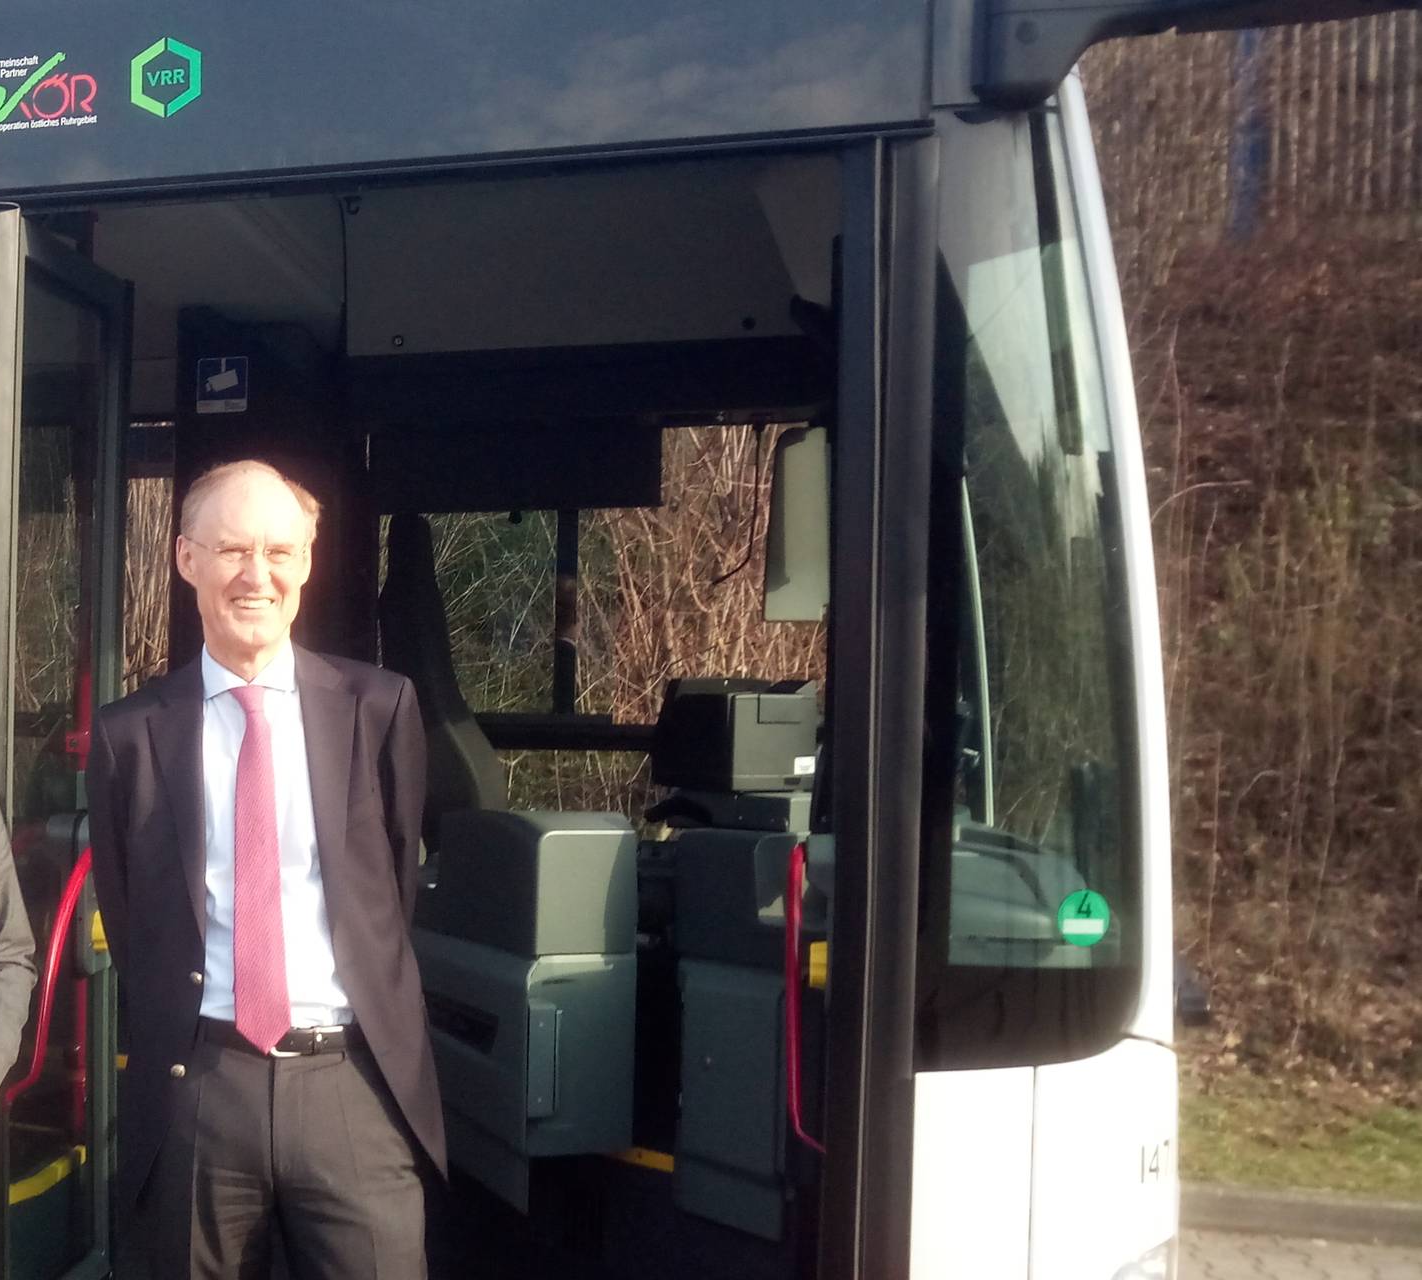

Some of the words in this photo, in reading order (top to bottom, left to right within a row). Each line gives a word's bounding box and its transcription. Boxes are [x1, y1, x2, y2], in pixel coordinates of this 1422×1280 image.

[0, 68, 28, 78] Partner
[146, 68, 185, 87] VRR
[30, 118, 60, 129] östliches
[60, 115, 97, 126] Ruhrgebiet
[1077, 891, 1091, 918] 4
